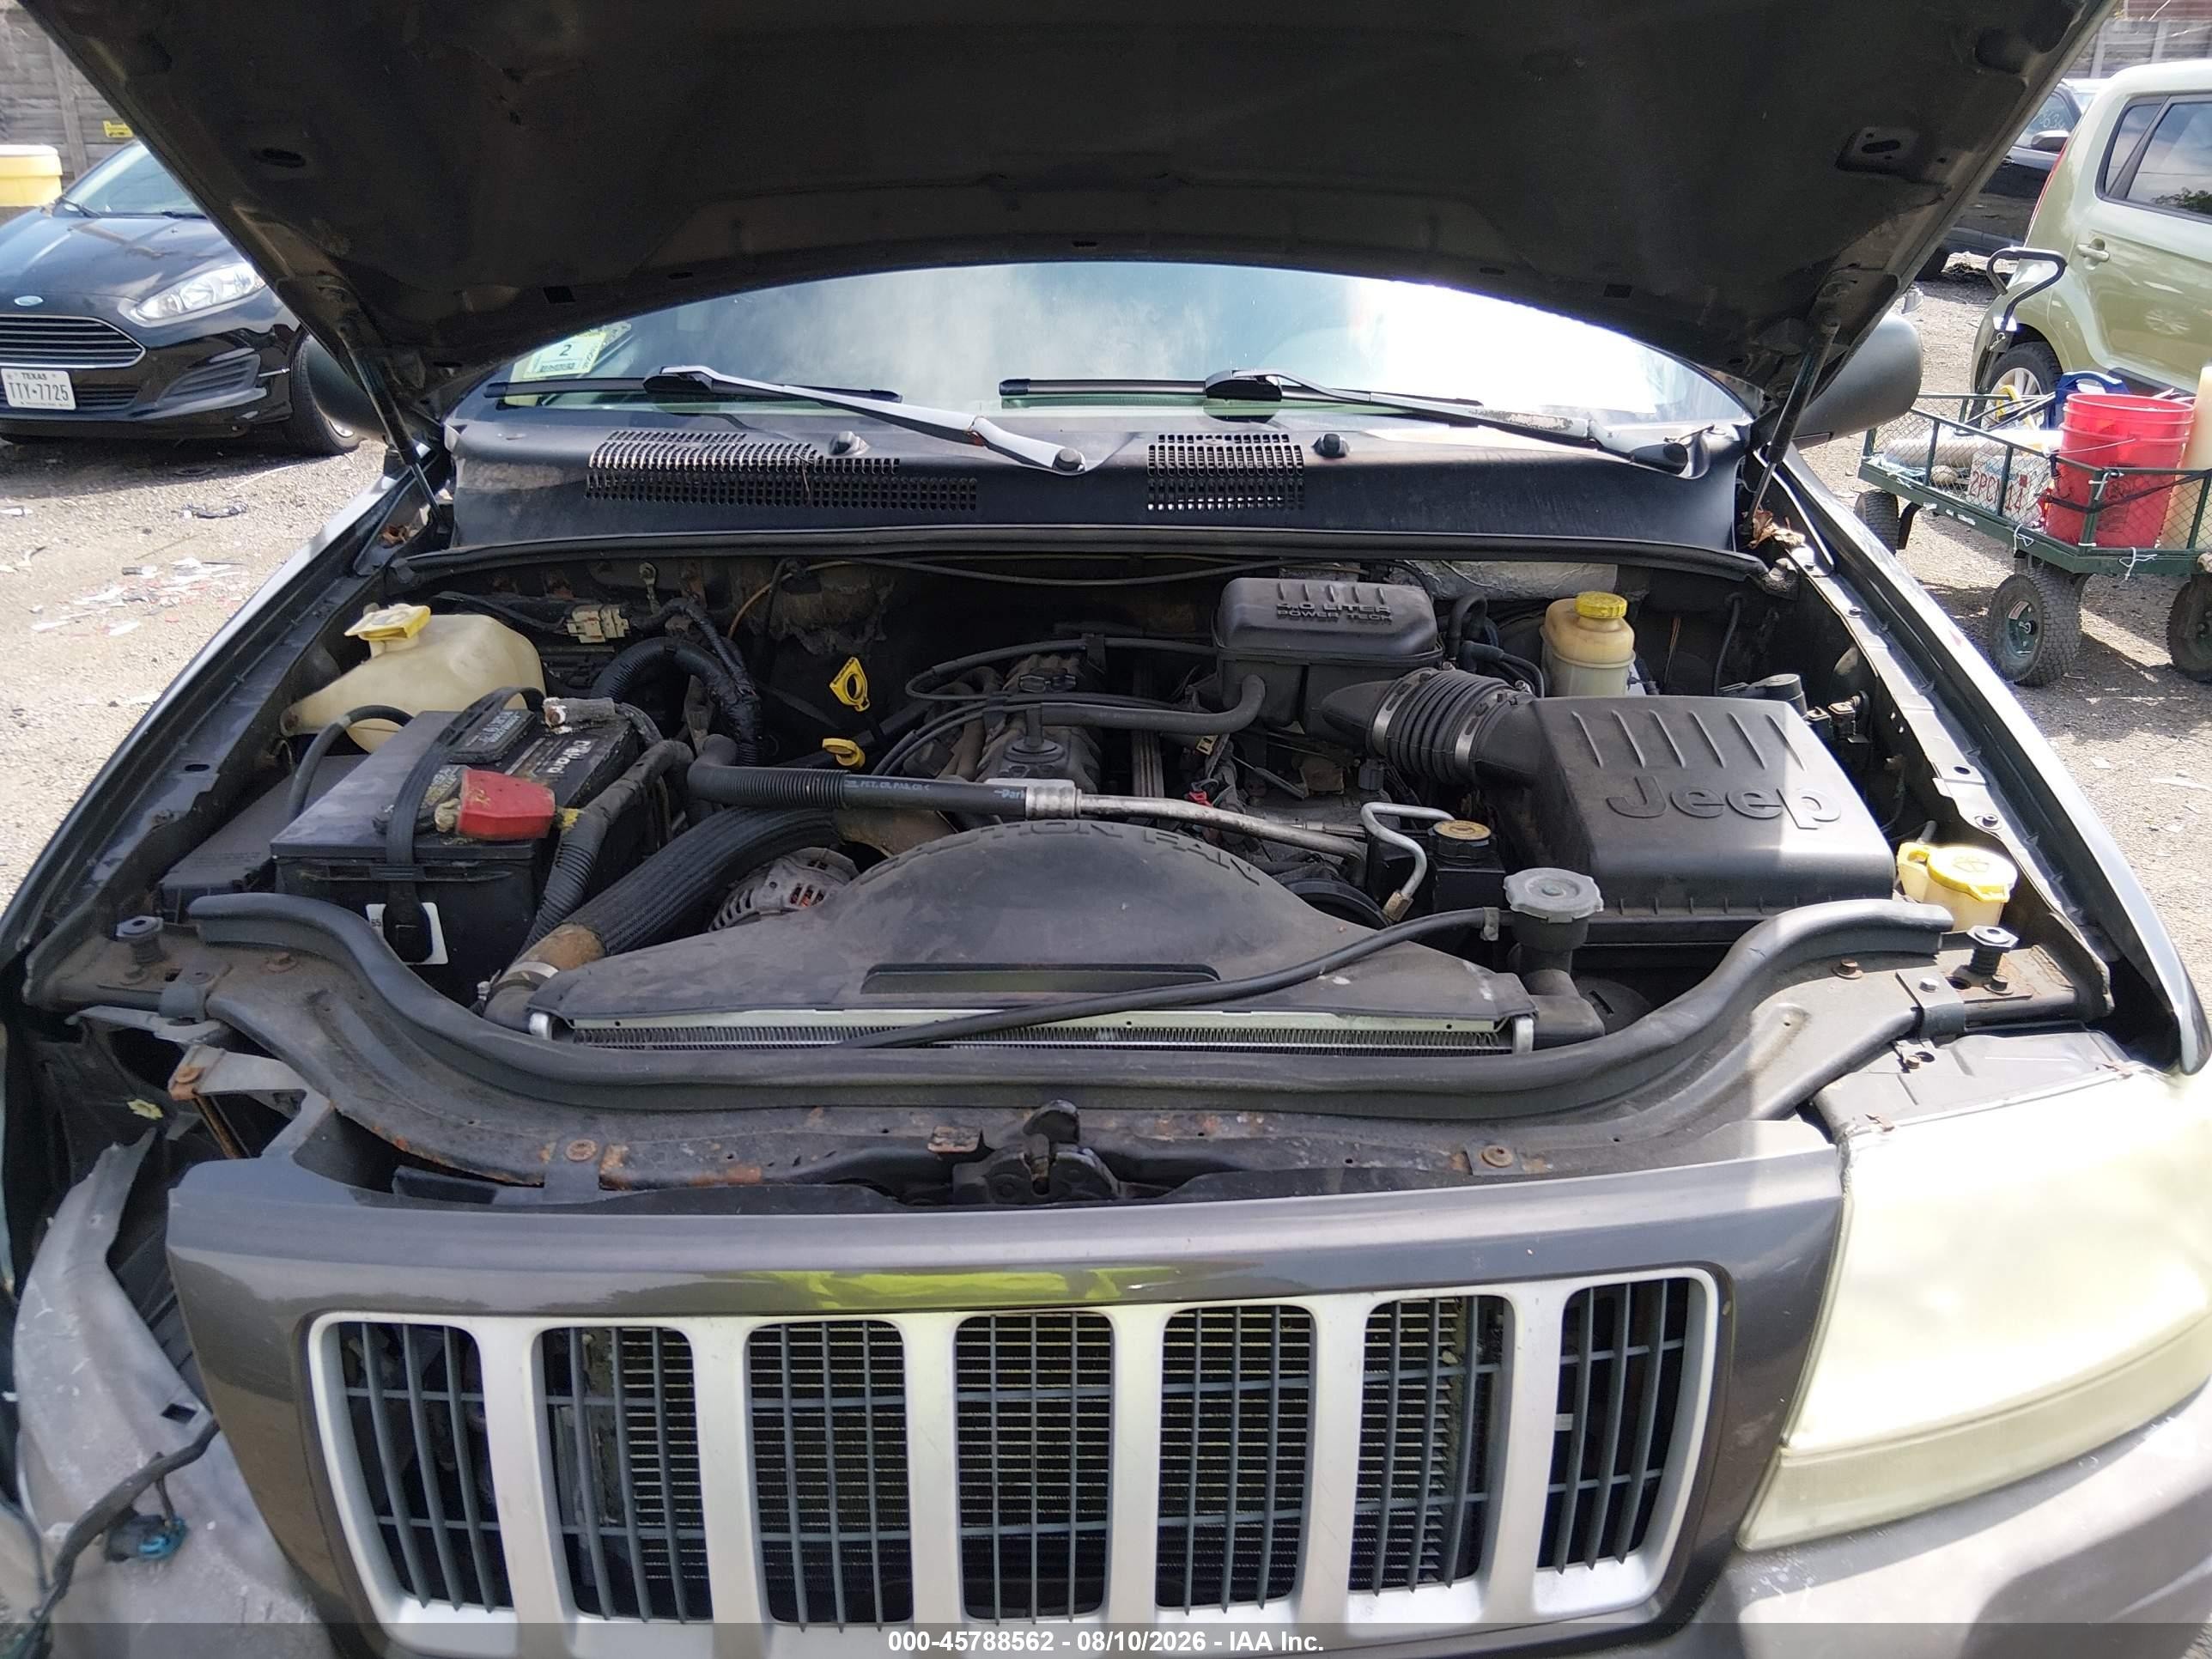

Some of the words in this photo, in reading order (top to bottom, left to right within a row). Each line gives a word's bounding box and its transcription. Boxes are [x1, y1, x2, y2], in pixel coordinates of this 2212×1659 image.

[559, 344, 572, 356] 2
[21, 372, 47, 380] TEXAS
[1322, 603, 1391, 613] LITER
[1277, 610, 1340, 618] POWER
[1346, 612, 1393, 622] TECH
[1605, 775, 1841, 830] Jeep
[1144, 829, 1260, 886] FAN
